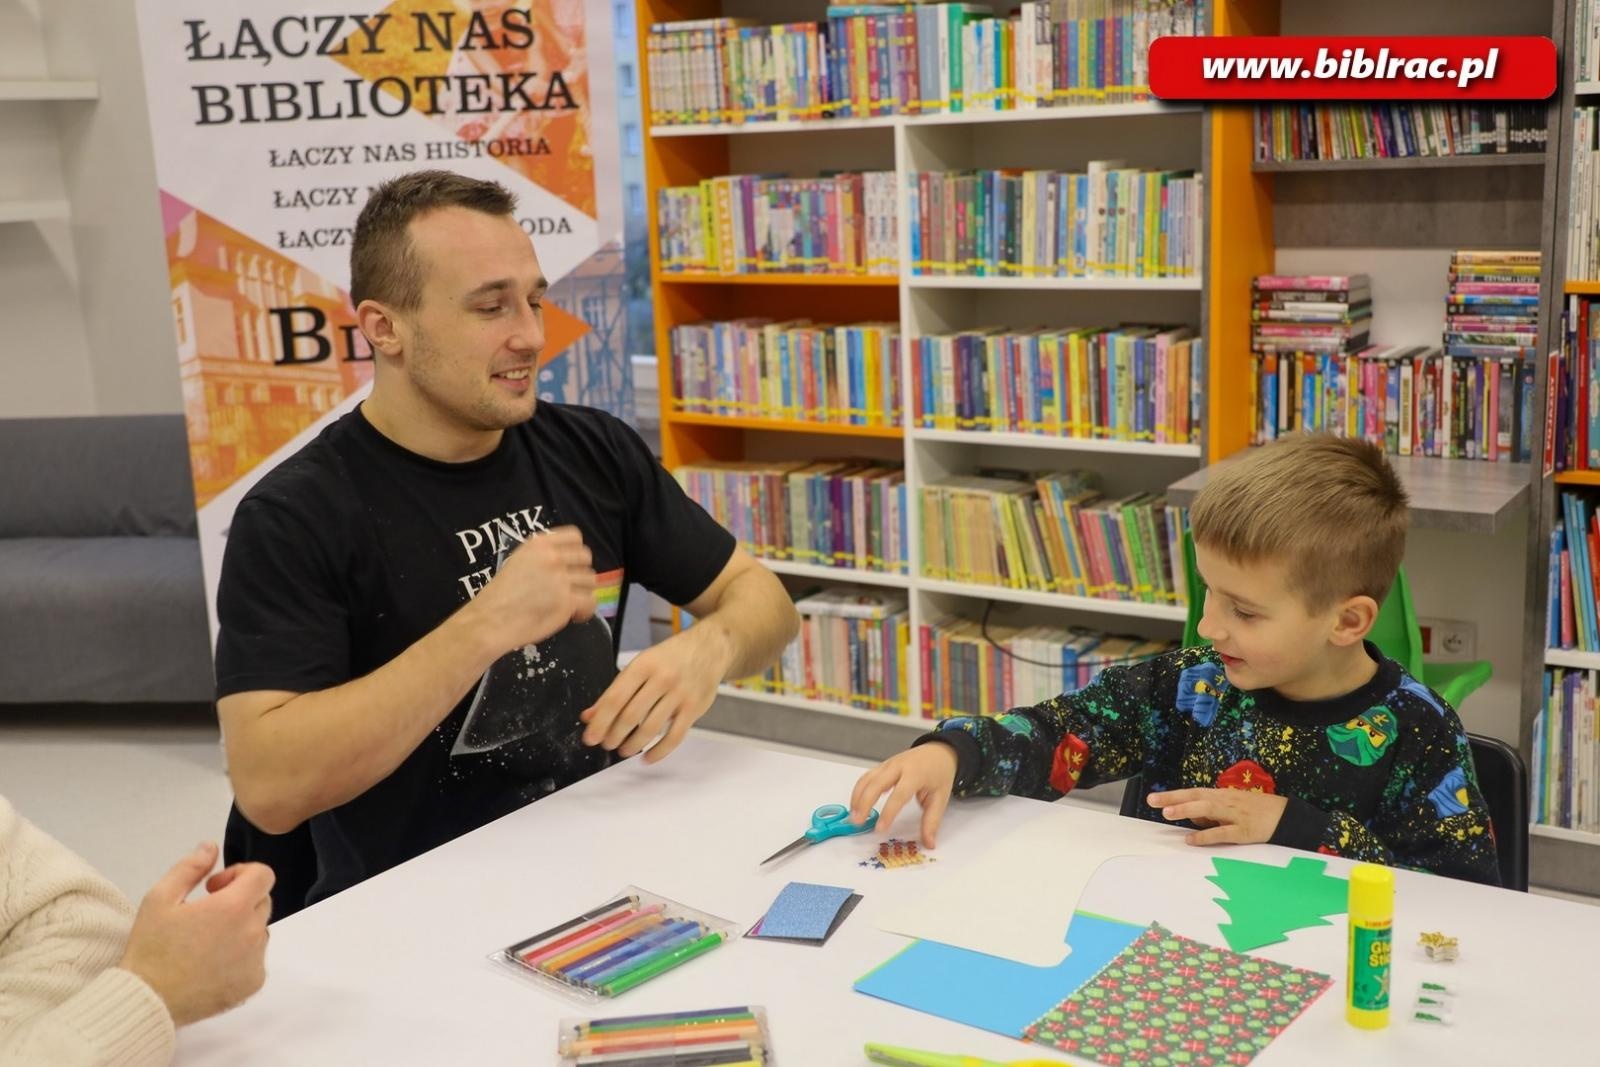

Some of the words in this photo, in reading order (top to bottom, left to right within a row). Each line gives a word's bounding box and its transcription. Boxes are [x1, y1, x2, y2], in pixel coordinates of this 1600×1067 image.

[184, 14, 391, 66] ŁĄCZY
[411, 8, 534, 51] NAS
[191, 70, 579, 125] BIBLIOTEKA
[269, 145, 354, 169] ŁĄCZY
[363, 143, 417, 163] NAS
[425, 136, 552, 160] HISTORIA
[273, 187, 358, 211] ŁĄCZY
[456, 505, 550, 565] PINK
